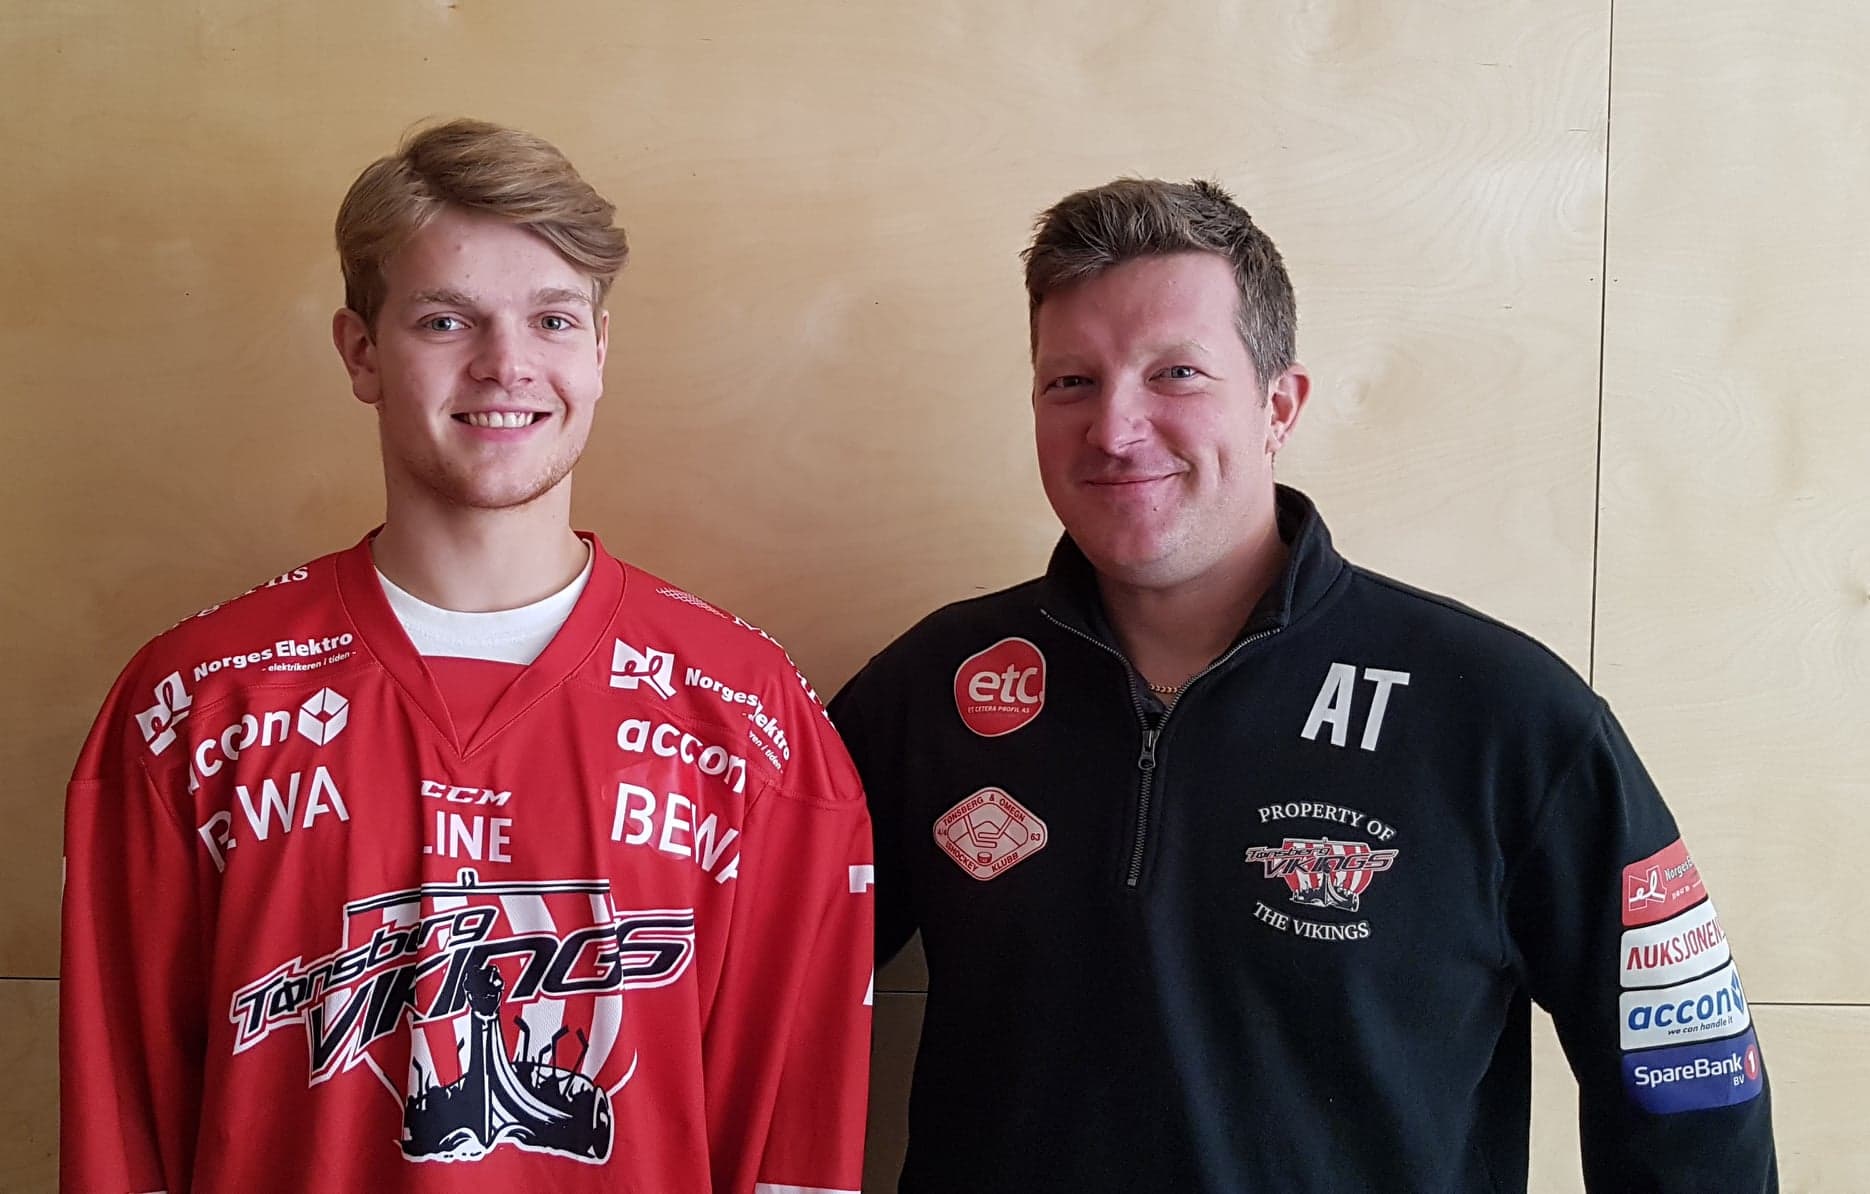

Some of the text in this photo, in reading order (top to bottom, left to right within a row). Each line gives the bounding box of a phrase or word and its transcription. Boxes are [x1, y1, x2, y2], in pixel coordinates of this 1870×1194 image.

[193, 633, 354, 682] Norges Elektro
[328, 652, 350, 664] tiden
[685, 667, 759, 707] Norges
[748, 700, 790, 761] lektro
[1300, 662, 1411, 751] AT
[187, 709, 290, 795] ccon
[617, 716, 746, 794] accon
[421, 779, 513, 806] CCM
[999, 798, 1026, 822] OMEGN
[423, 811, 513, 863] INE
[1258, 803, 1395, 841] PROPERTY OF
[1253, 902, 1370, 941] THE VIKINGS
[1628, 987, 1732, 1031] accon
[1667, 1028, 1681, 1036] we
[1682, 1025, 1699, 1034] can
[1700, 1017, 1727, 1031] handle
[1634, 1052, 1743, 1089] SpareBank
[1733, 1073, 1746, 1086] BV
